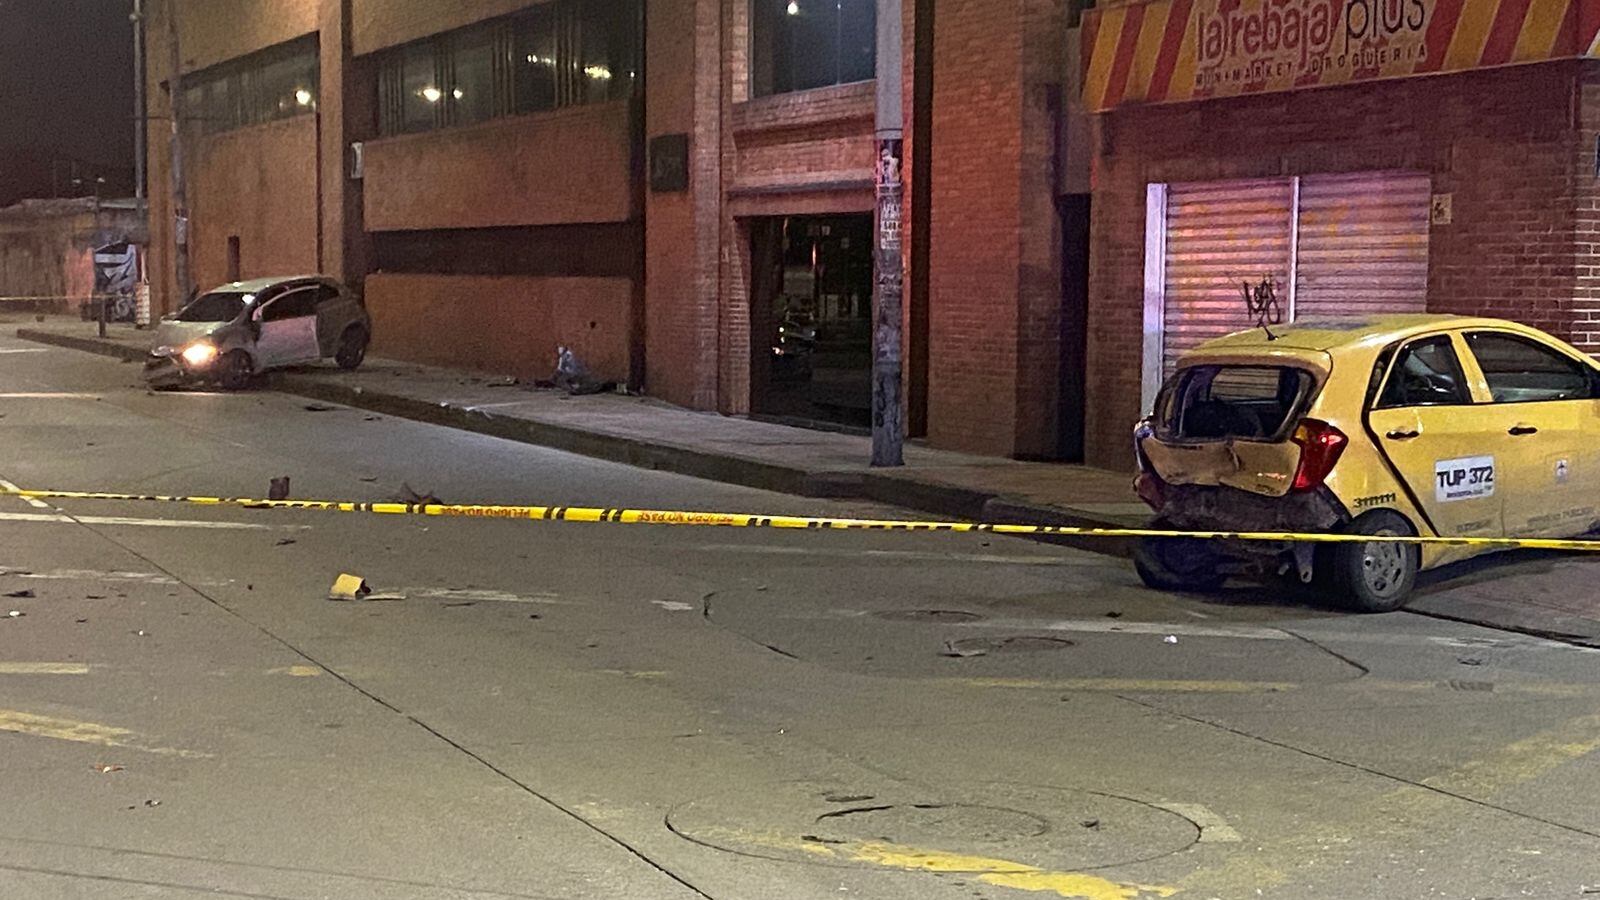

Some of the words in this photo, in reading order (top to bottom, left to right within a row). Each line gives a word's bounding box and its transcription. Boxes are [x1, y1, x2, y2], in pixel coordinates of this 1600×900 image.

[1346, 0, 1425, 54] plus
[1437, 469, 1466, 488] TUP
[1469, 466, 1493, 484] 372
